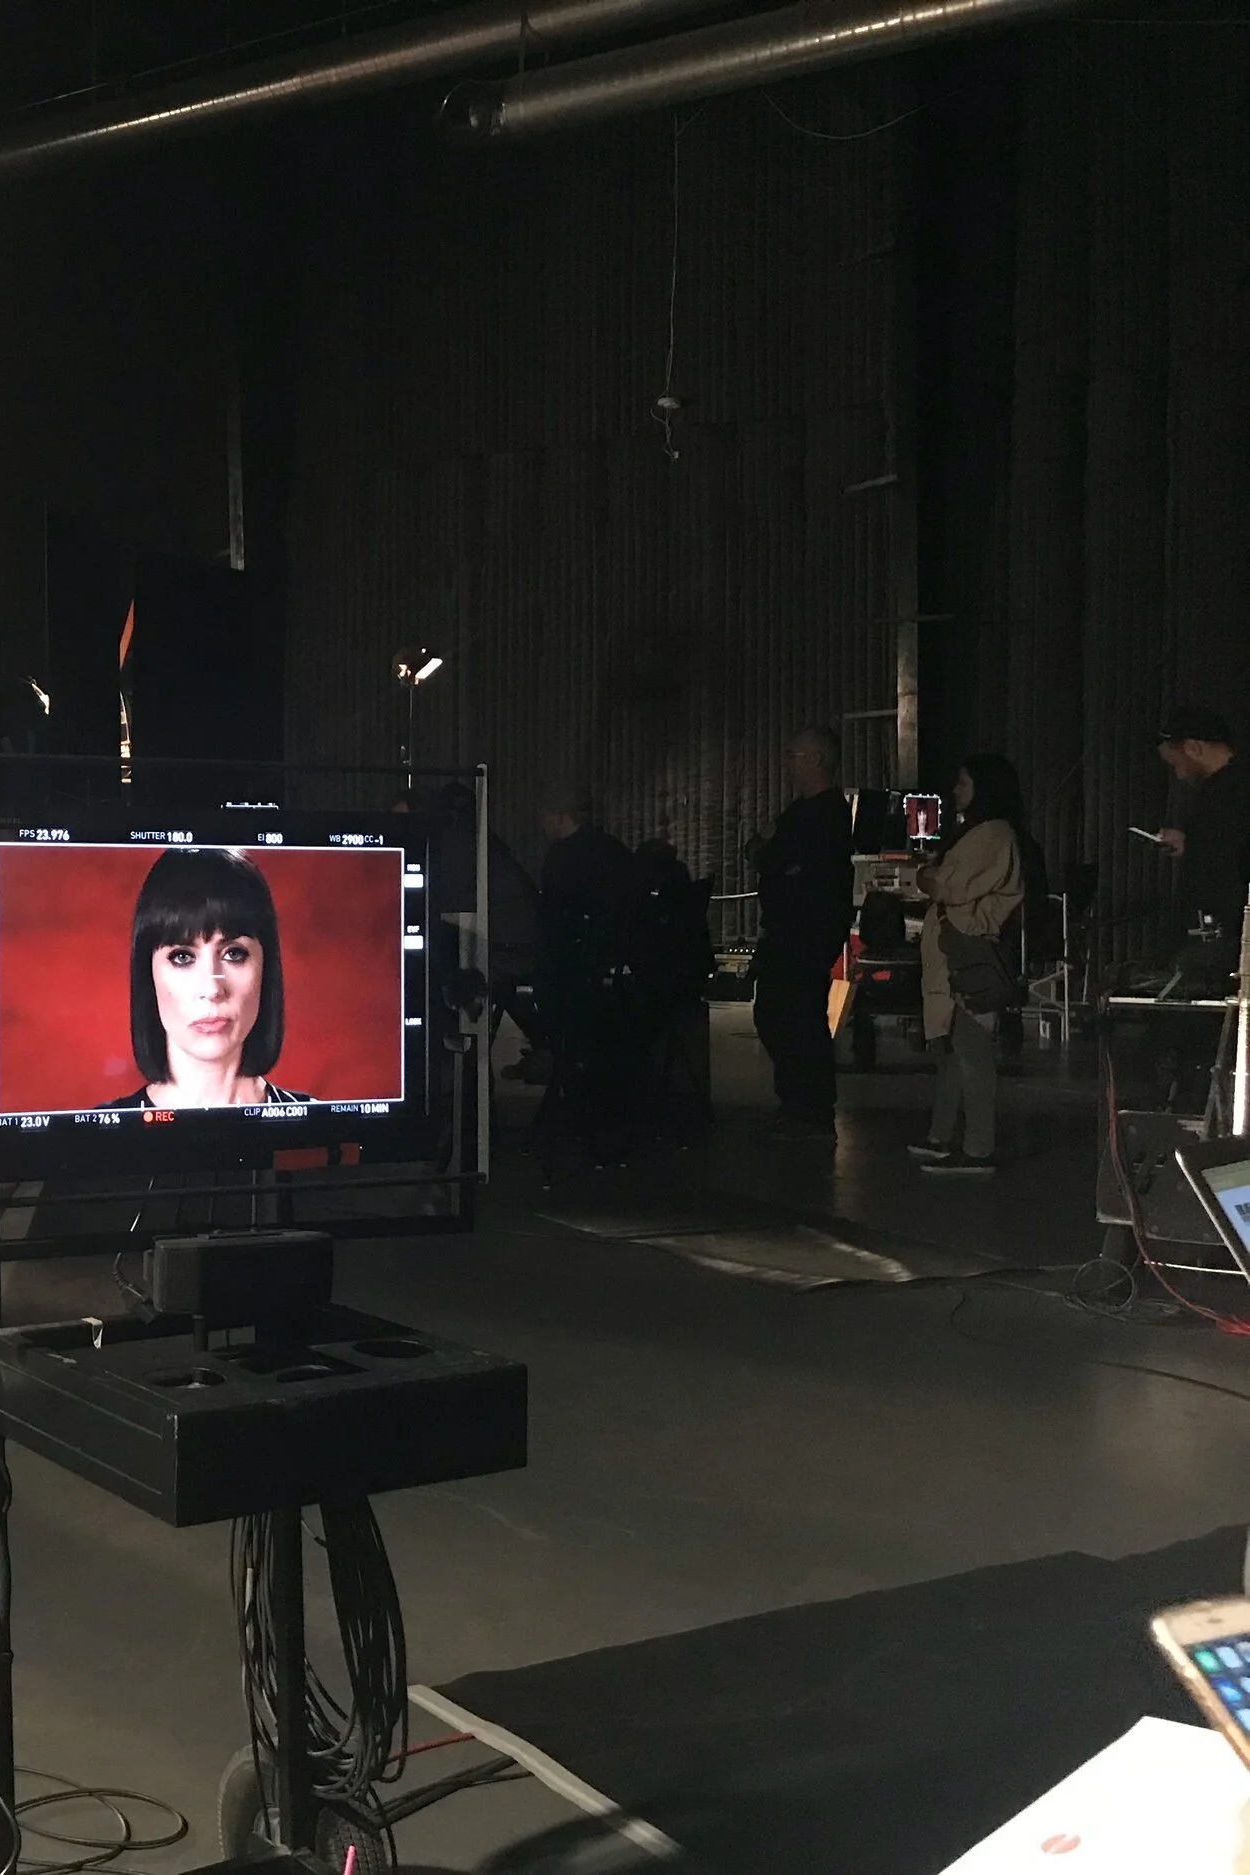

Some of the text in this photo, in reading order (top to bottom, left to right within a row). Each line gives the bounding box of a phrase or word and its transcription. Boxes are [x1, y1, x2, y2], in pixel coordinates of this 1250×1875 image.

[19, 829, 70, 841] FPS 23.976
[130, 831, 193, 843] SHUTTER 180.0
[258, 833, 284, 844] EI 800
[329, 834, 341, 843] WB
[342, 834, 364, 846] 2900
[244, 1107, 261, 1117] CLIP
[330, 1103, 389, 1114] REMAIN 10 MIN
[75, 1114, 91, 1124] BAT
[155, 1111, 175, 1122] REC
